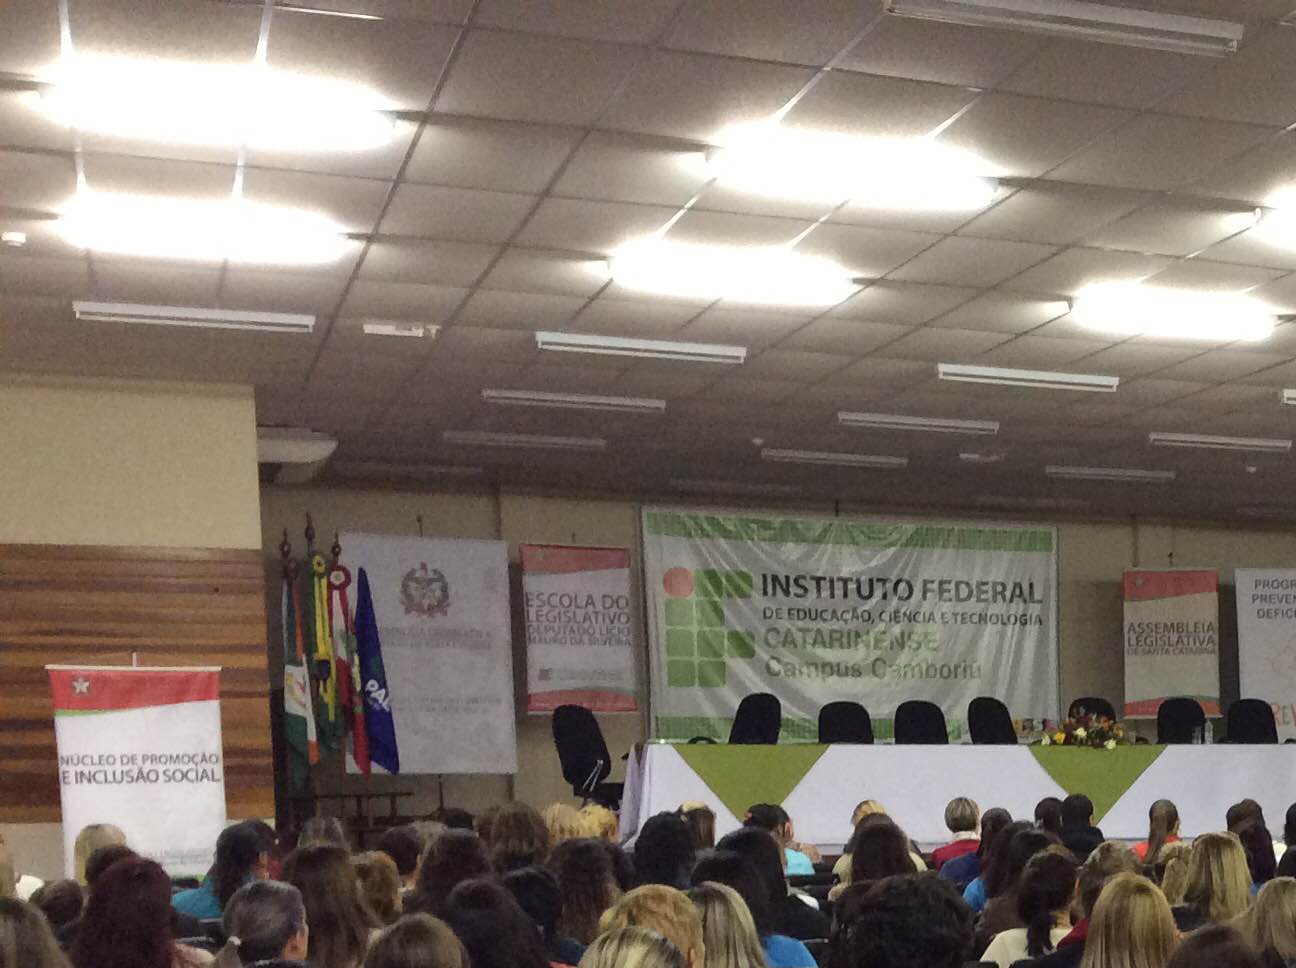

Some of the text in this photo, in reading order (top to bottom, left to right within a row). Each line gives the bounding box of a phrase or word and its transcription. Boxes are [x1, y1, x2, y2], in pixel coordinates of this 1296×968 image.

[761, 573, 1044, 605] INSTITUTO FEDERAL
[525, 591, 630, 610] ESCOLA DO
[526, 608, 631, 625] LEGISLATIVO
[763, 606, 1043, 628] DE EDUCAÇÃO, CIÊNCIA E TECNOLOGIA
[1127, 621, 1216, 635] ASSEMBLEIA
[763, 627, 938, 653] CATARINENSE
[1127, 634, 1216, 648] LEGISLATIVA
[765, 656, 862, 680] Campus
[60, 752, 219, 769] NÚCLEO DE PROMOÇÃO
[62, 767, 221, 785] E INCLUSÃO SOCIAL
